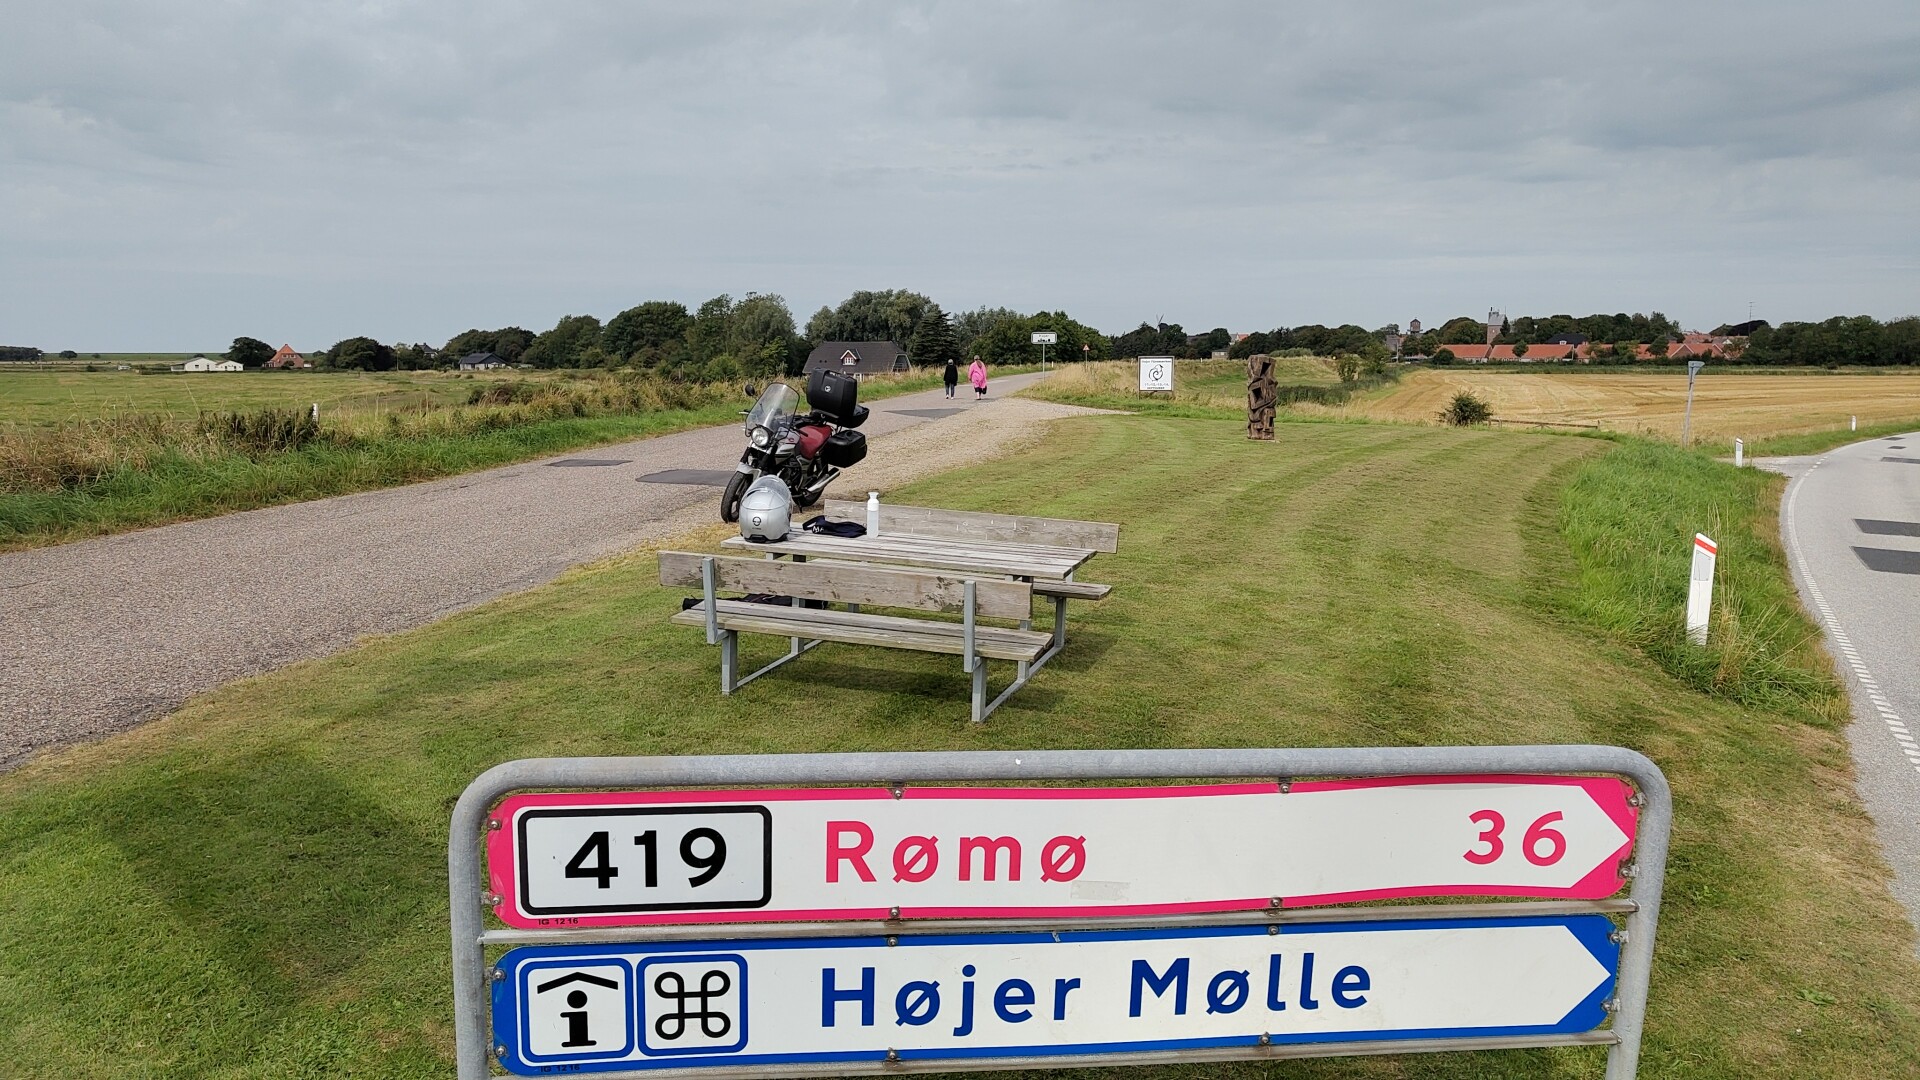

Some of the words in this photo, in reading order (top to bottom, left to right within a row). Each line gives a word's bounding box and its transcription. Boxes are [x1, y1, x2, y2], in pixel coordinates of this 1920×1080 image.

[565, 828, 726, 888] 419
[825, 820, 1086, 883] Rømø
[1463, 809, 1567, 867] 36
[822, 964, 1081, 1036] Højer
[1129, 952, 1371, 1018] Mølle
